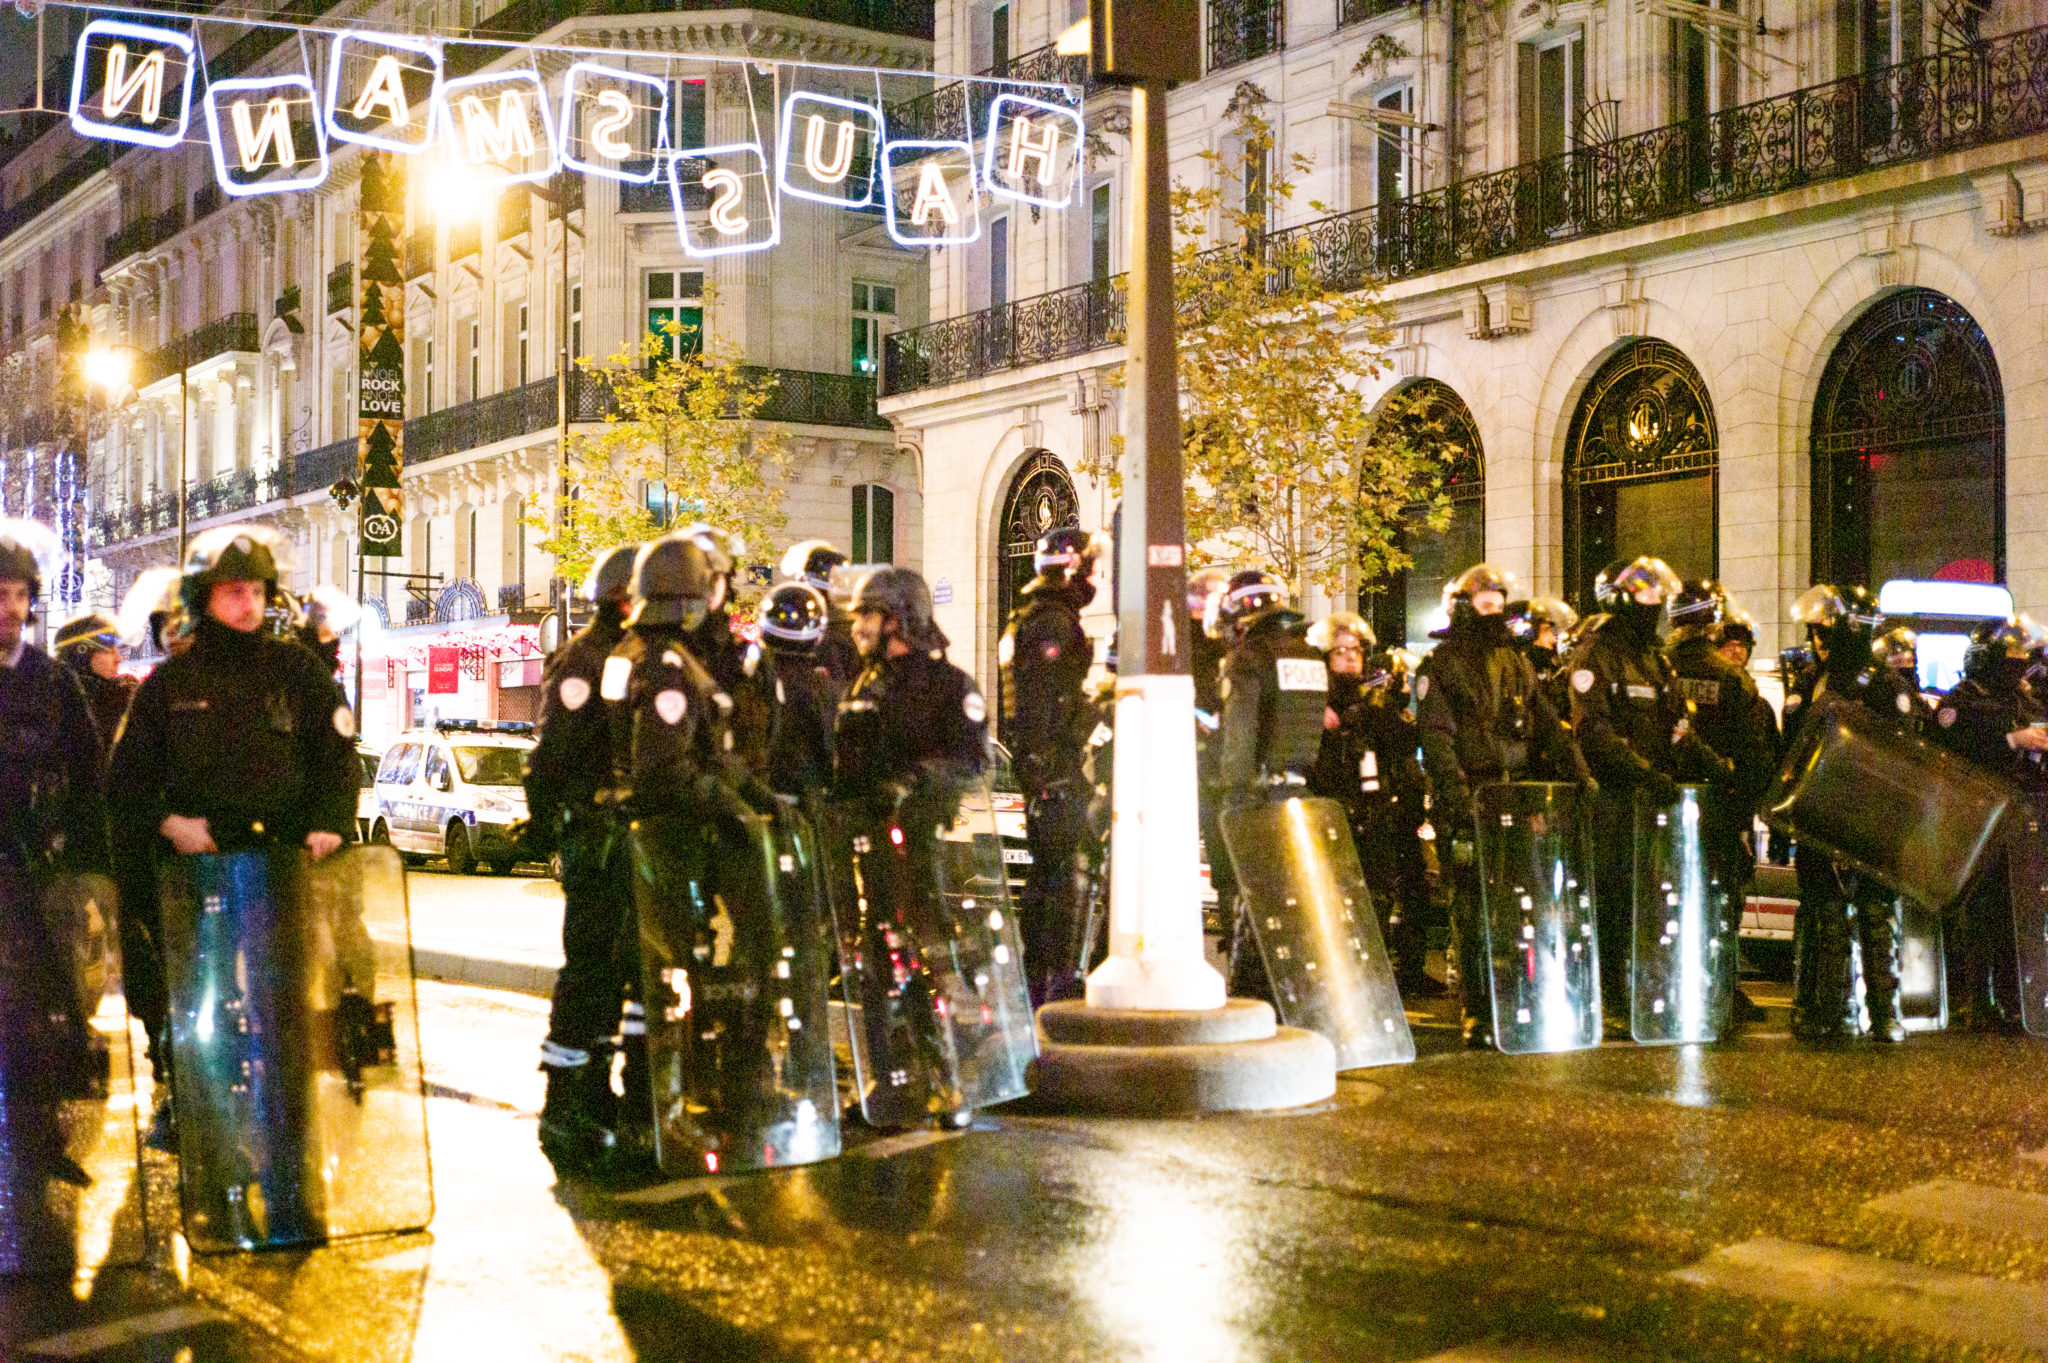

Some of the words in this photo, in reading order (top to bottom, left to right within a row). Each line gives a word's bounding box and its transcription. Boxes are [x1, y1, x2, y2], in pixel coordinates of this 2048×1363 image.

[361, 379, 400, 391] ROCK
[361, 400, 401, 413] LOVE
[369, 521, 391, 535] C&A
